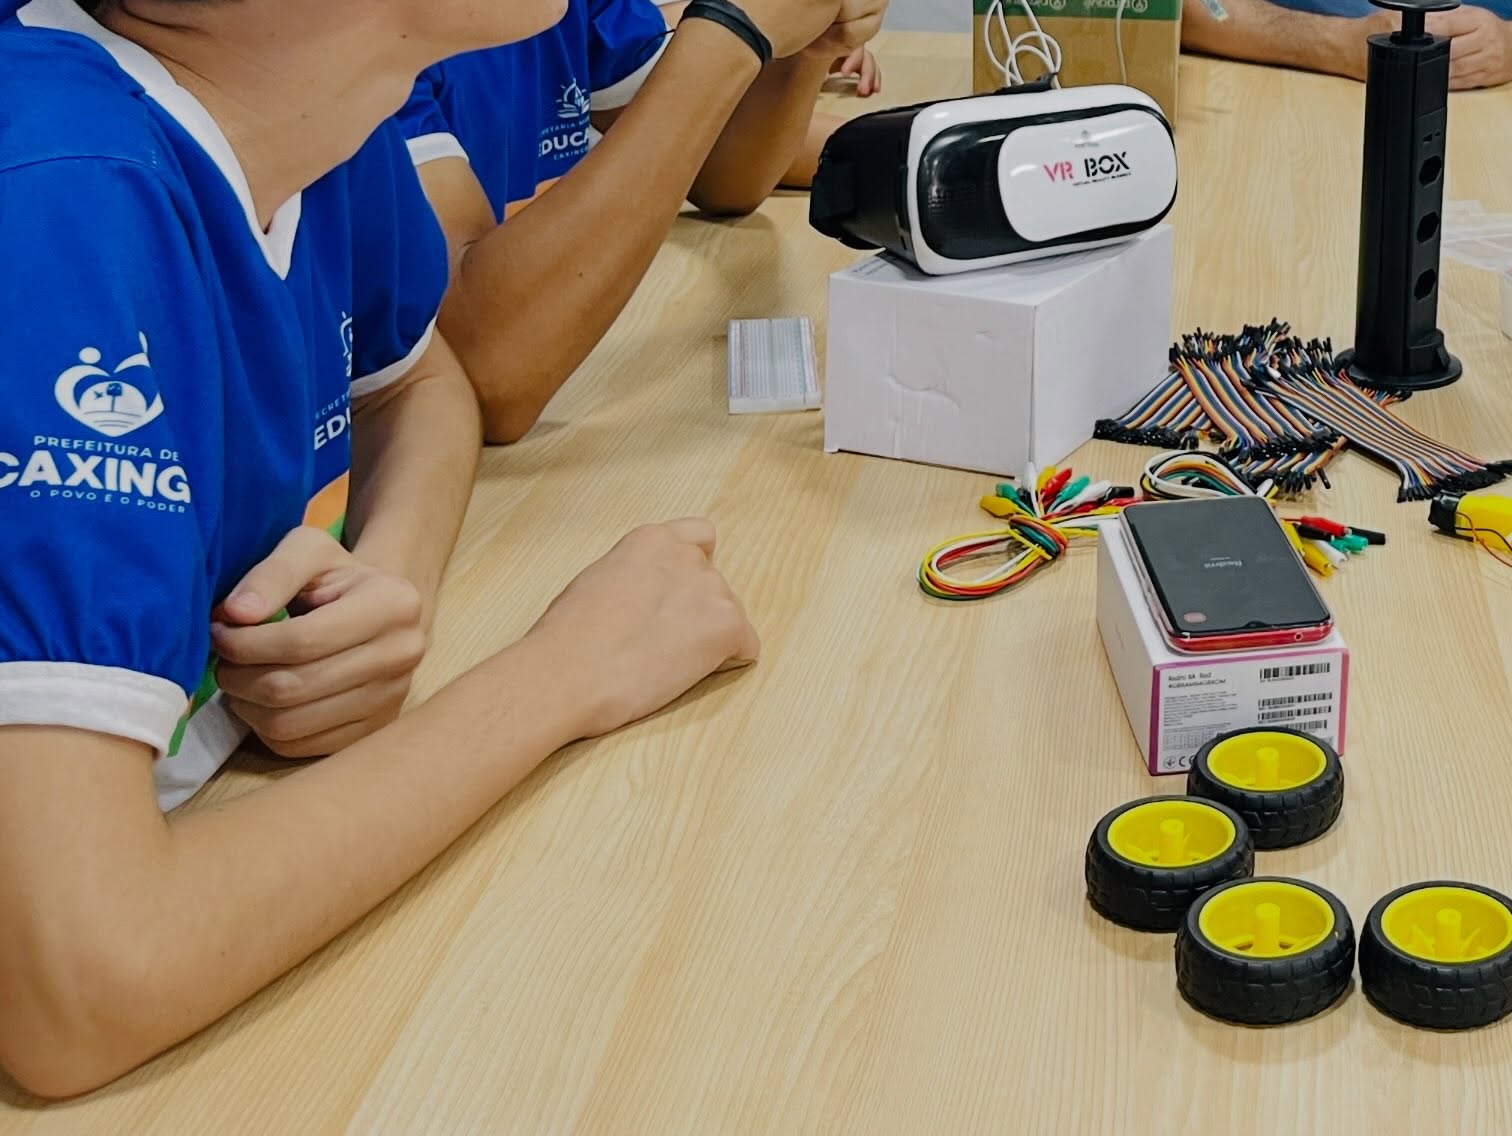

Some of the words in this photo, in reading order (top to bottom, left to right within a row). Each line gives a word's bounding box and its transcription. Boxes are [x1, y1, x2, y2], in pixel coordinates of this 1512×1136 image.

[1043, 161, 1074, 182] VR
[1084, 151, 1130, 177] BOX
[34, 435, 152, 458] PREFEITURA
[160, 449, 180, 462] DE
[30, 489, 41, 498] O
[50, 489, 97, 501] POVO
[120, 496, 130, 505] O
[137, 499, 186, 514] PODER
